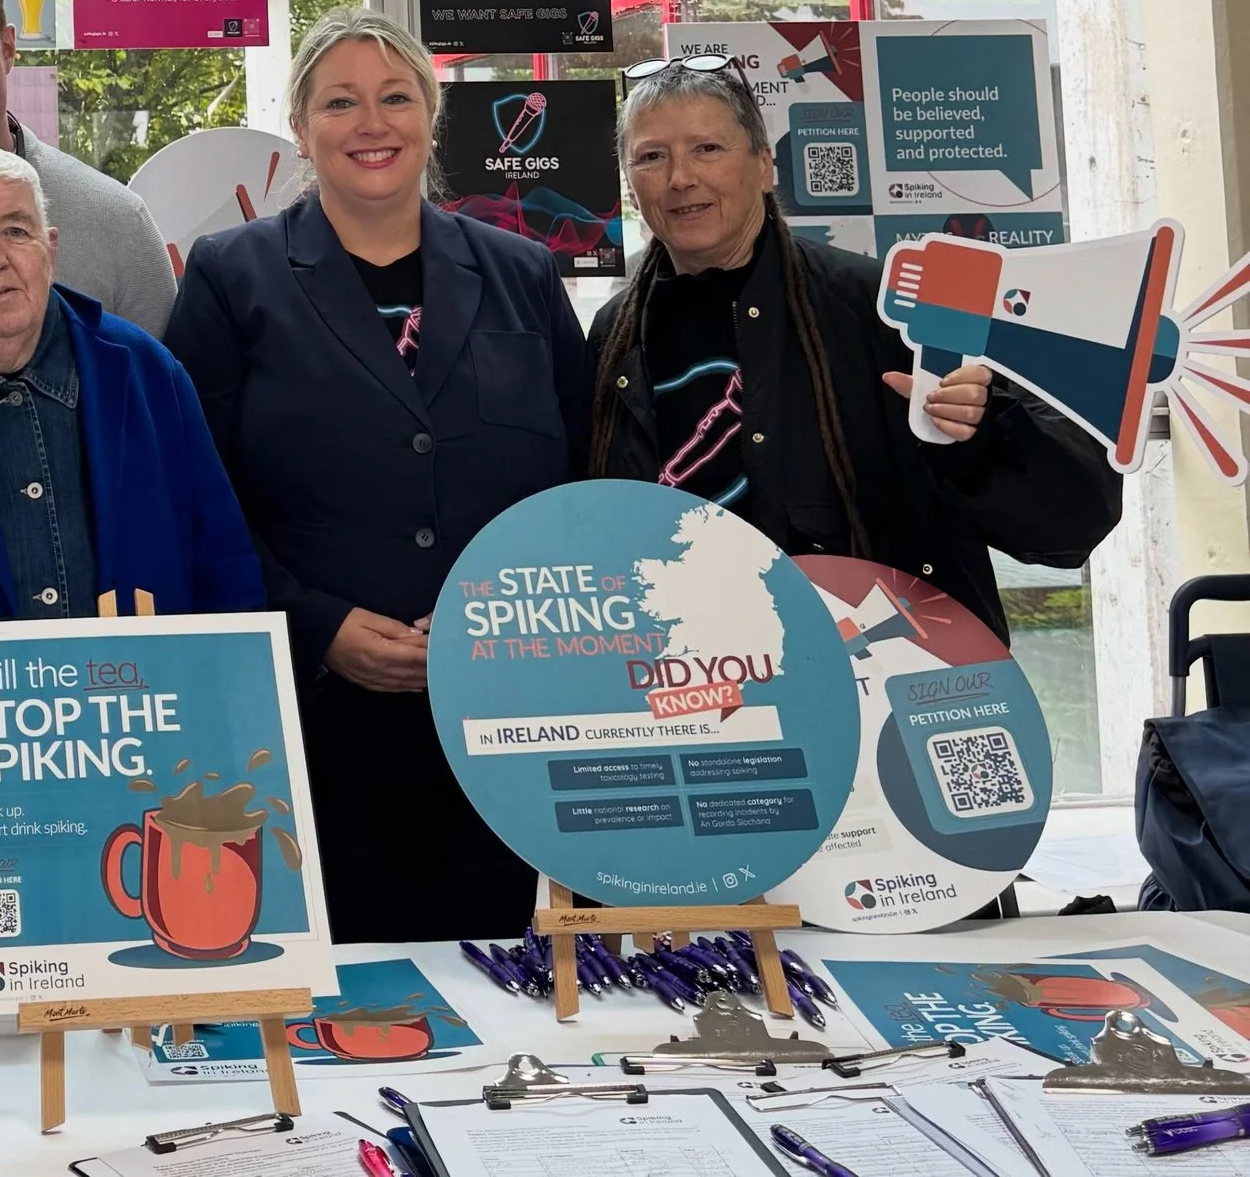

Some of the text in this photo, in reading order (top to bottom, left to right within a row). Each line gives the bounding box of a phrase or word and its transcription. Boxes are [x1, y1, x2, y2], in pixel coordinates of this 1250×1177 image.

[432, 8, 567, 20] WE WANT SAFE GIGS
[892, 87, 999, 105] People should
[894, 106, 985, 122] be believed,
[798, 127, 860, 136] PETITION HERE
[896, 125, 974, 142] supported
[897, 144, 1007, 162] and protected.
[485, 157, 559, 170] SAFE GIGS
[989, 231, 1053, 244] REALITY
[459, 565, 626, 598] THE STATE OF
[464, 595, 636, 636] SPIKING
[471, 633, 664, 660] AT THE MOMENT
[26, 658, 78, 688] the
[86, 660, 144, 688] tea,
[626, 654, 774, 690] DID YOU
[907, 672, 993, 701] SIGN OUR
[655, 685, 733, 715] KNOW?
[88, 694, 181, 734] THE
[910, 702, 1010, 726] PETITION HERE
[480, 723, 720, 745] IN IRELAND CURRENTLY THERE IS...
[573, 765, 602, 773] Limited
[743, 756, 782, 765] legislation
[6, 806, 25, 819] up.
[626, 804, 659, 812] research
[11, 822, 41, 835] drink
[44, 820, 88, 836] spiking.
[841, 827, 876, 839] support
[597, 871, 707, 895] spikinginireland.ie
[875, 874, 937, 893] Spiking
[879, 884, 957, 907] in Ireland
[9, 960, 68, 977] Spiking
[10, 974, 84, 991] in Ireland
